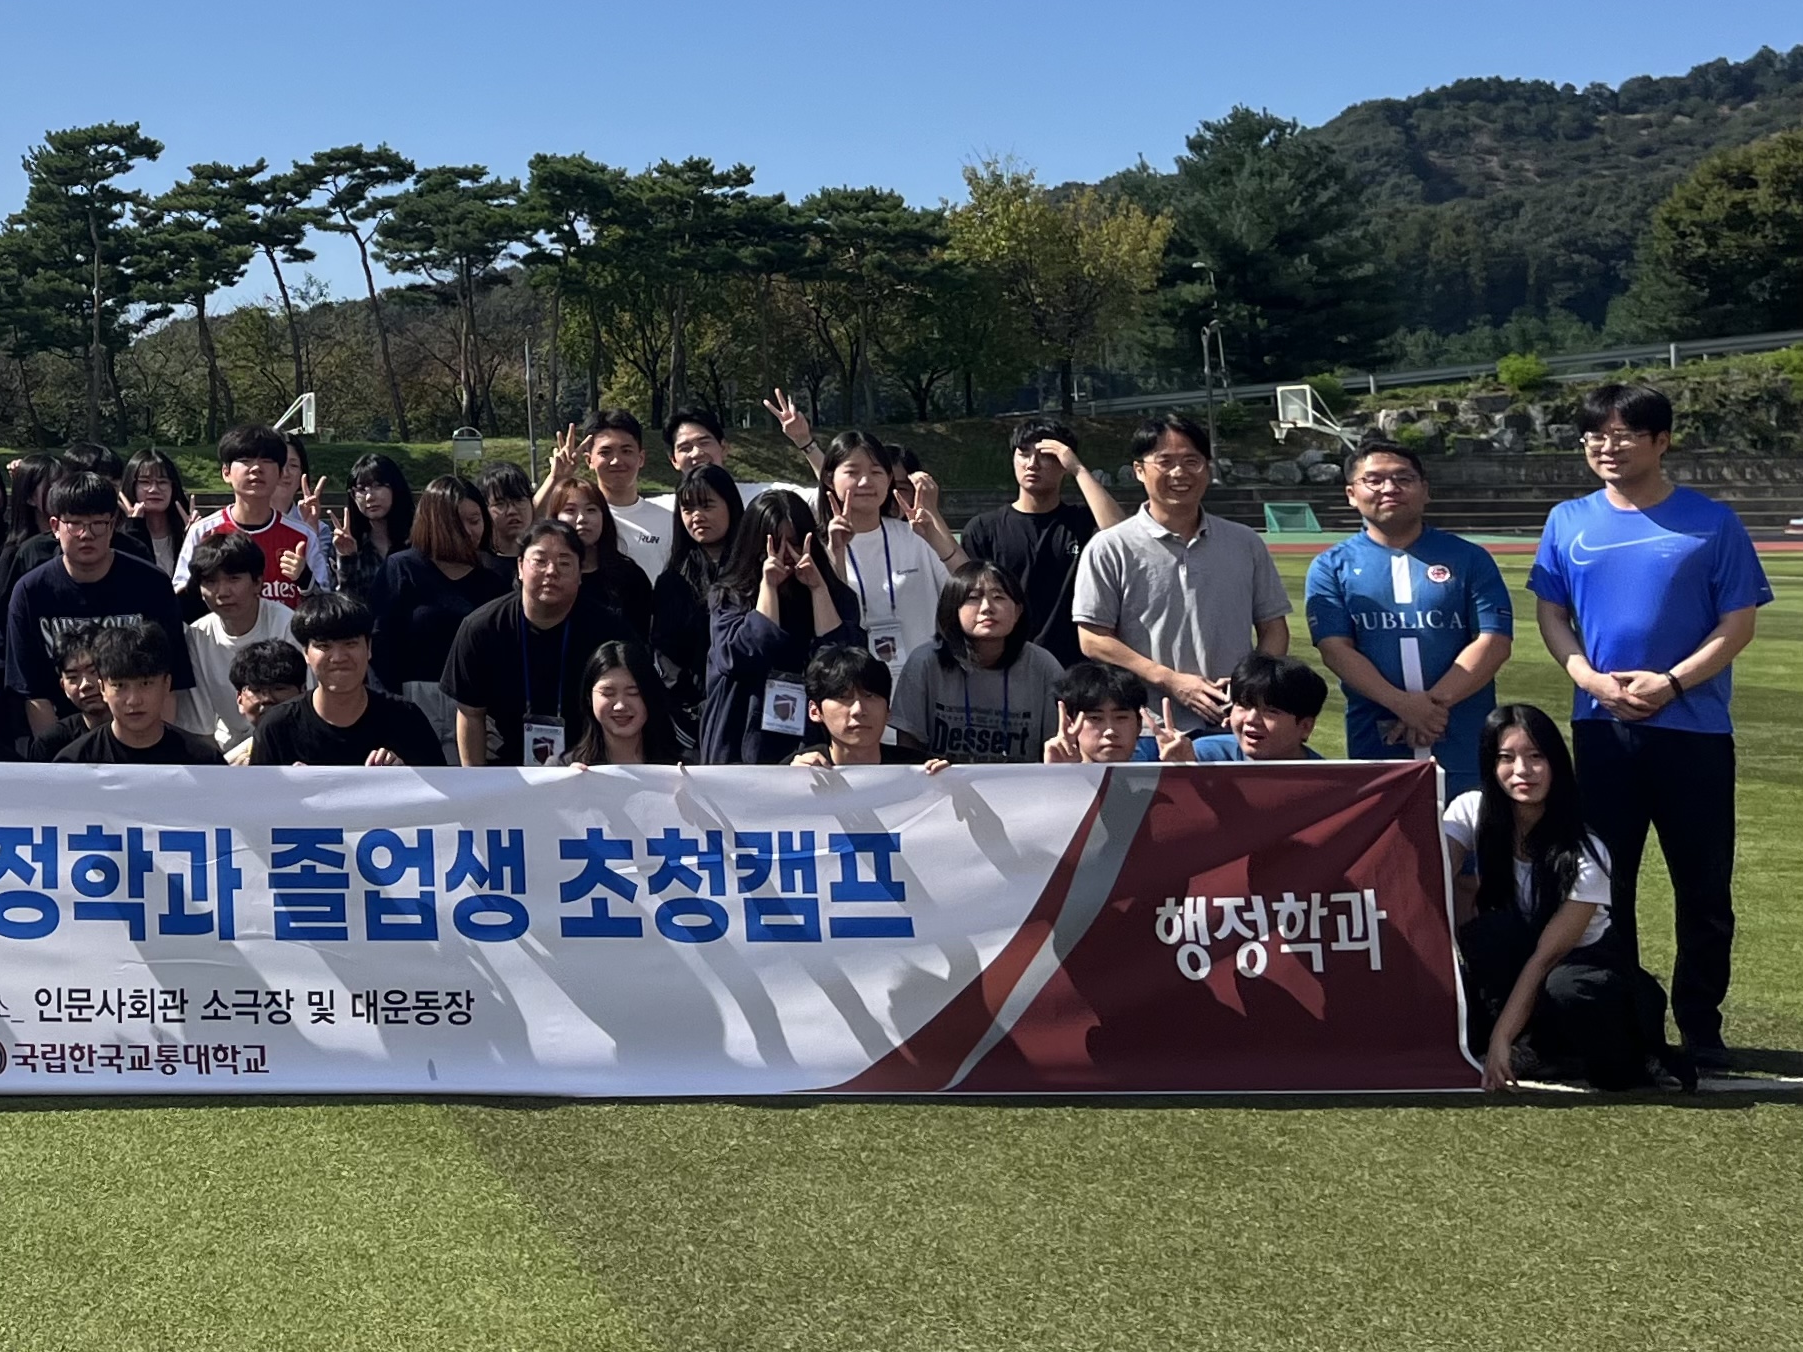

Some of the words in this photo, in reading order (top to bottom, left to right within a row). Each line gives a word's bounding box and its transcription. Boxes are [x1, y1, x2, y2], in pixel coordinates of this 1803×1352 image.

[261, 580, 297, 598] ates
[931, 717, 1030, 756] Dessert
[267, 827, 530, 943] 졸업생
[558, 827, 916, 944] 초청캠프
[1154, 888, 1388, 981] 행정학과
[34, 987, 189, 1024] 인문사회관
[200, 988, 294, 1025] 소극장
[307, 989, 336, 1025] 및
[351, 989, 475, 1026] 대운동장
[11, 1042, 270, 1076] 국립한국교통대학교
